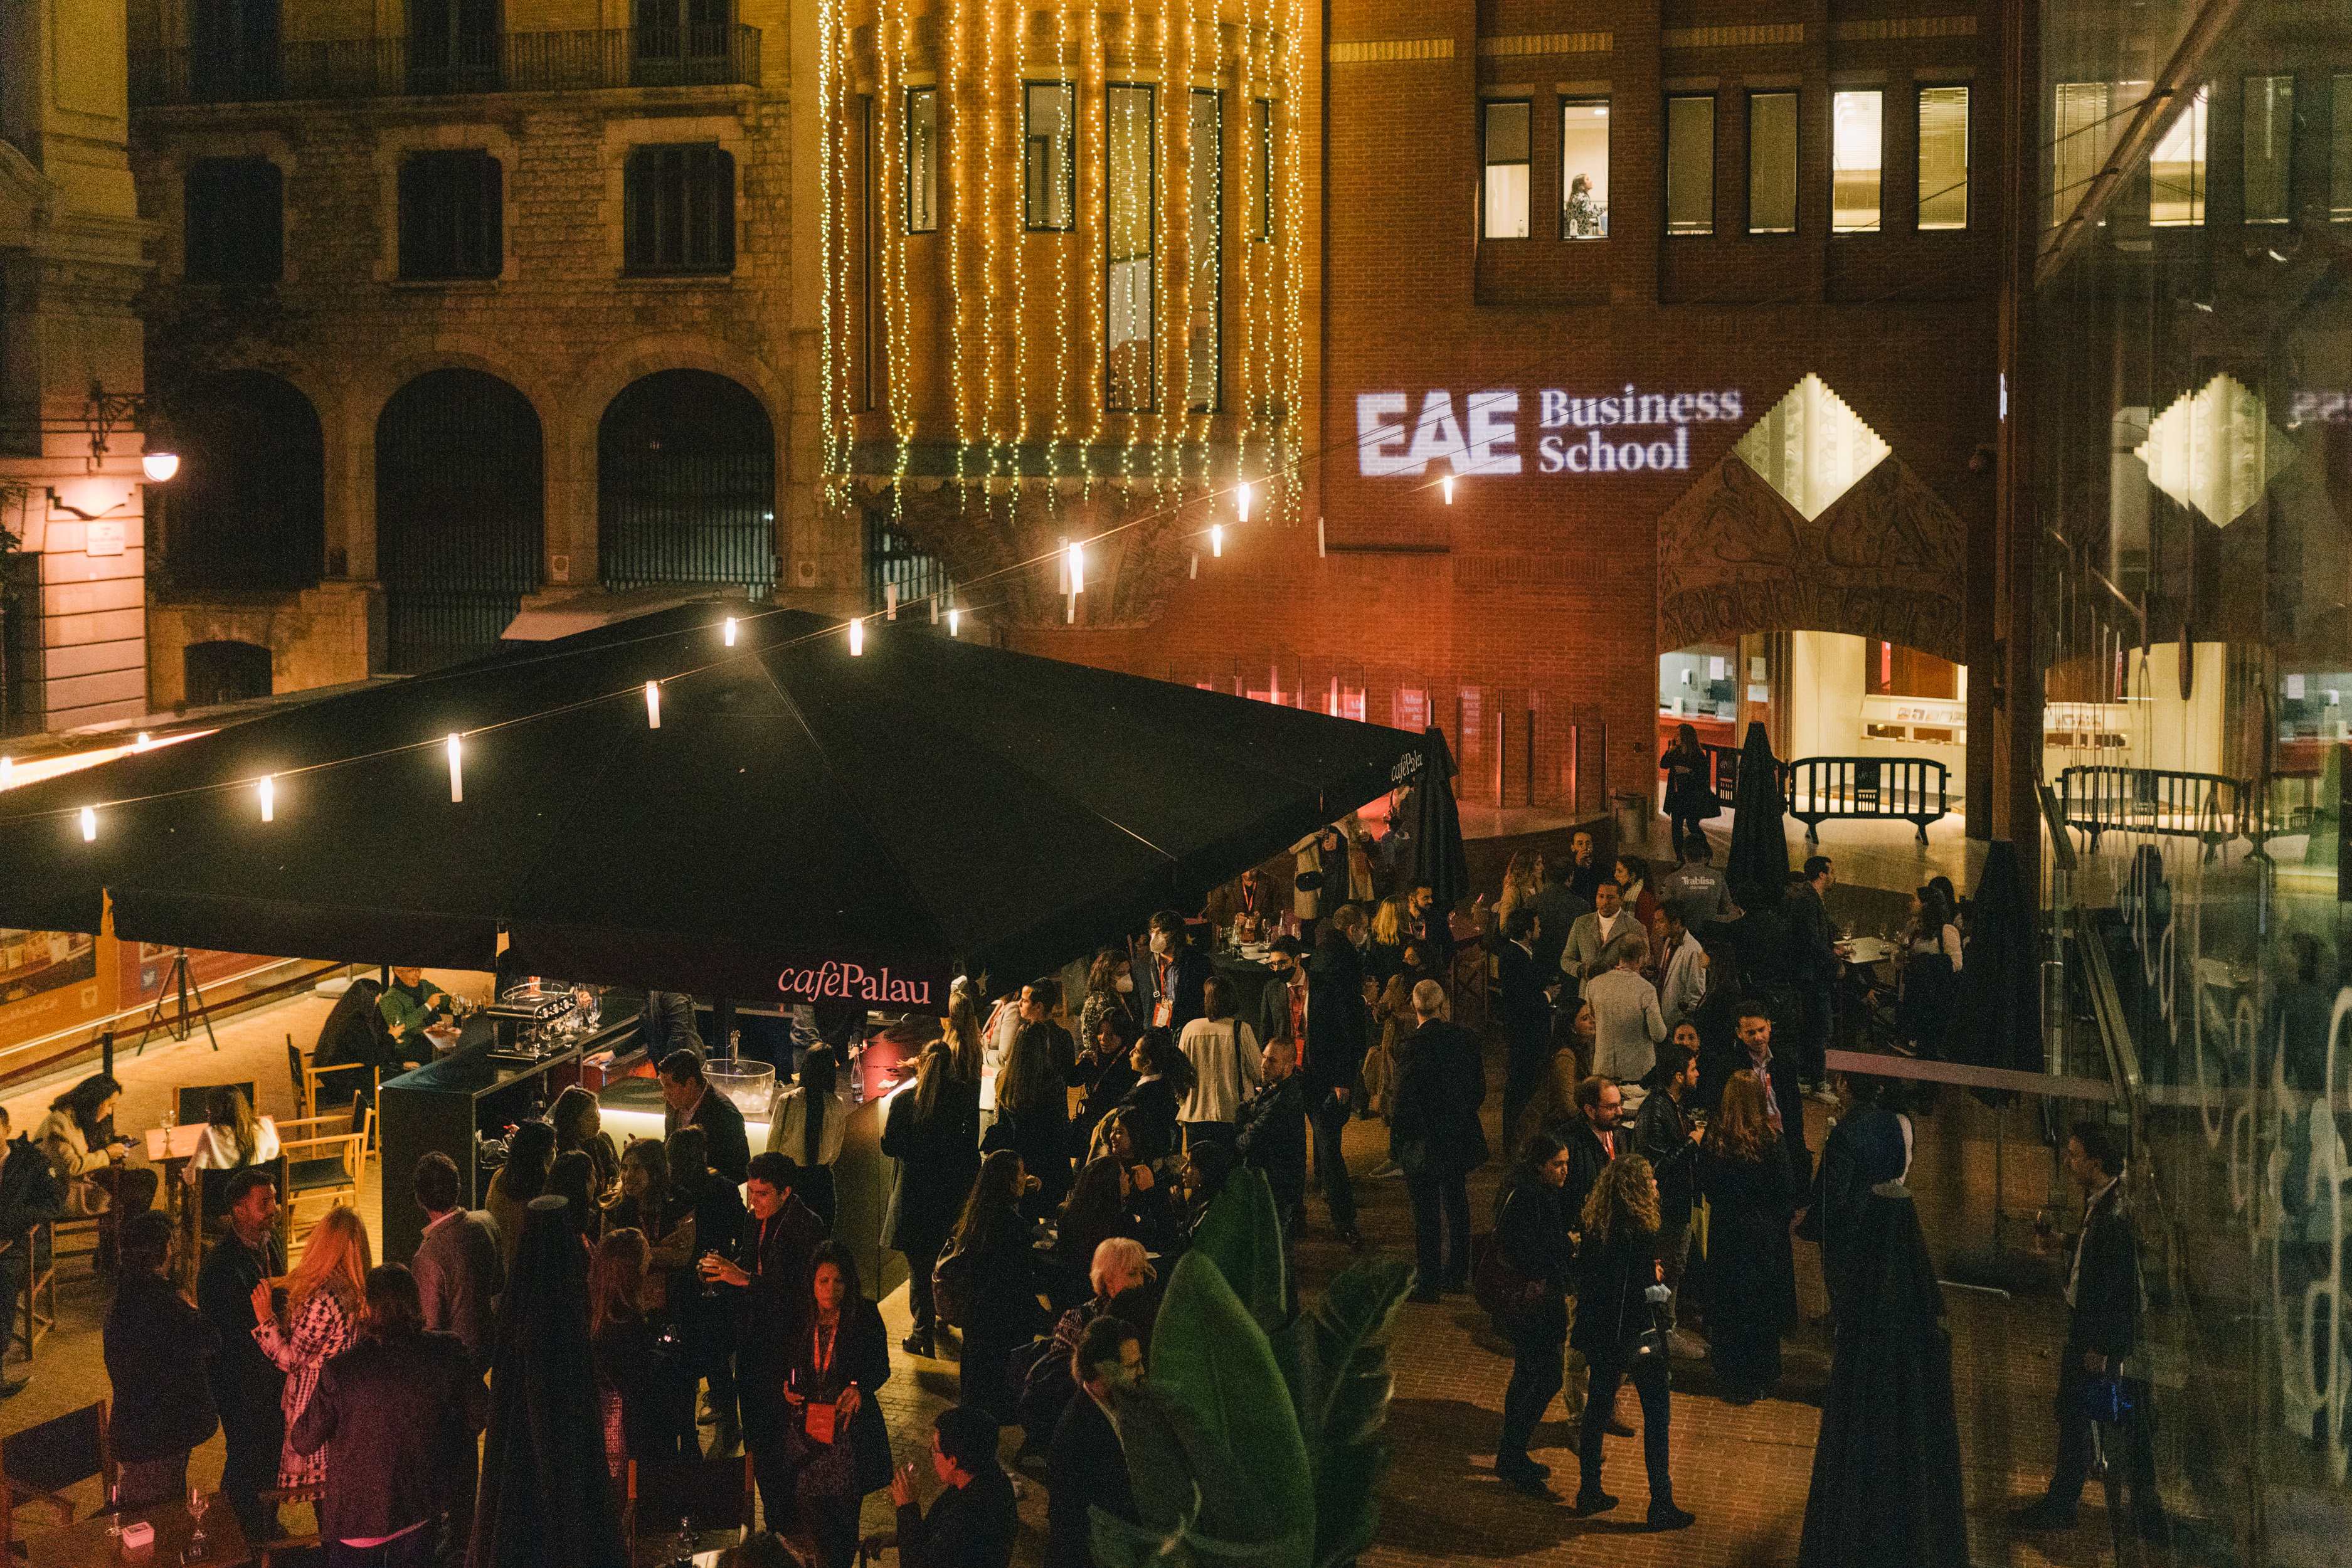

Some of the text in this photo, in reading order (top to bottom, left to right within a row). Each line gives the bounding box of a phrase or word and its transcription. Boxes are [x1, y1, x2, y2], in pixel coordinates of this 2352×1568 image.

[1539, 383, 1742, 427] Business
[1357, 390, 1522, 477] EAE
[1539, 425, 1688, 474] School
